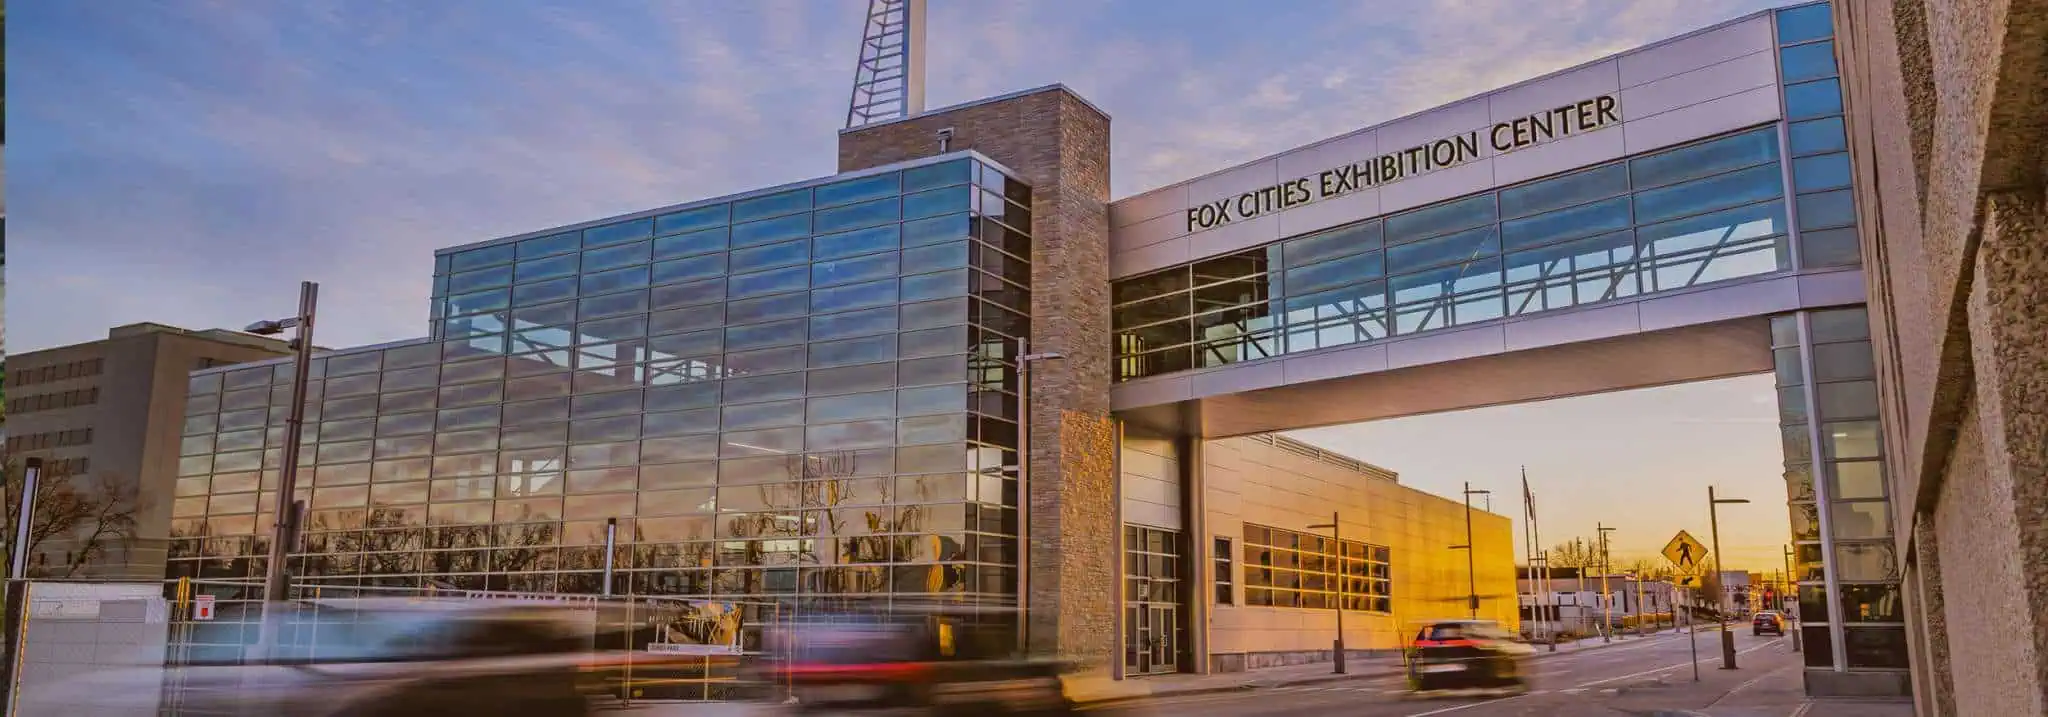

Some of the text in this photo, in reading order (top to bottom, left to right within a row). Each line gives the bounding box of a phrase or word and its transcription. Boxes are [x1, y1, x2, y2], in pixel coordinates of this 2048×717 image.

[1187, 95, 1618, 232] FOX CITIES EXHIBITION CENTER
